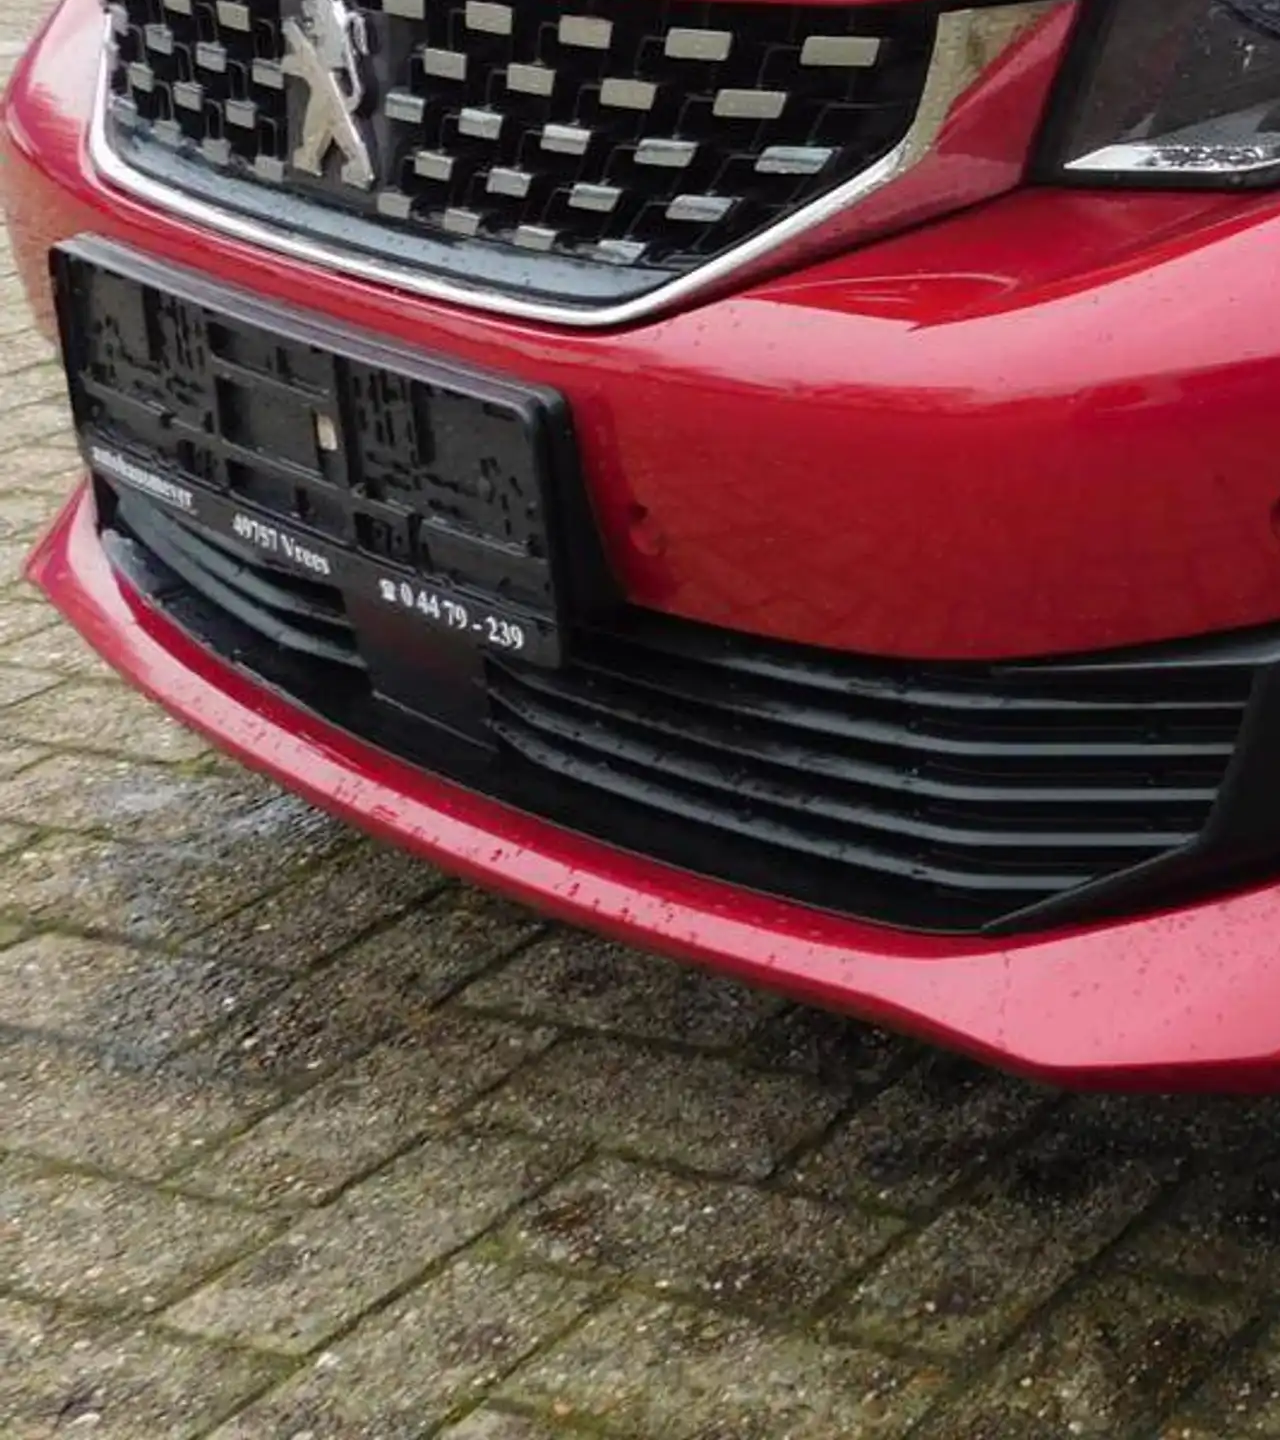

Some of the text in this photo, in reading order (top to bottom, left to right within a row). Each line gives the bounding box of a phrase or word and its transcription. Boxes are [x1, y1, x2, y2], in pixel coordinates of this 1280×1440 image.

[281, 533, 331, 575] Vrees
[416, 588, 441, 620] 44
[442, 599, 468, 629] 79
[485, 615, 524, 649] 239
